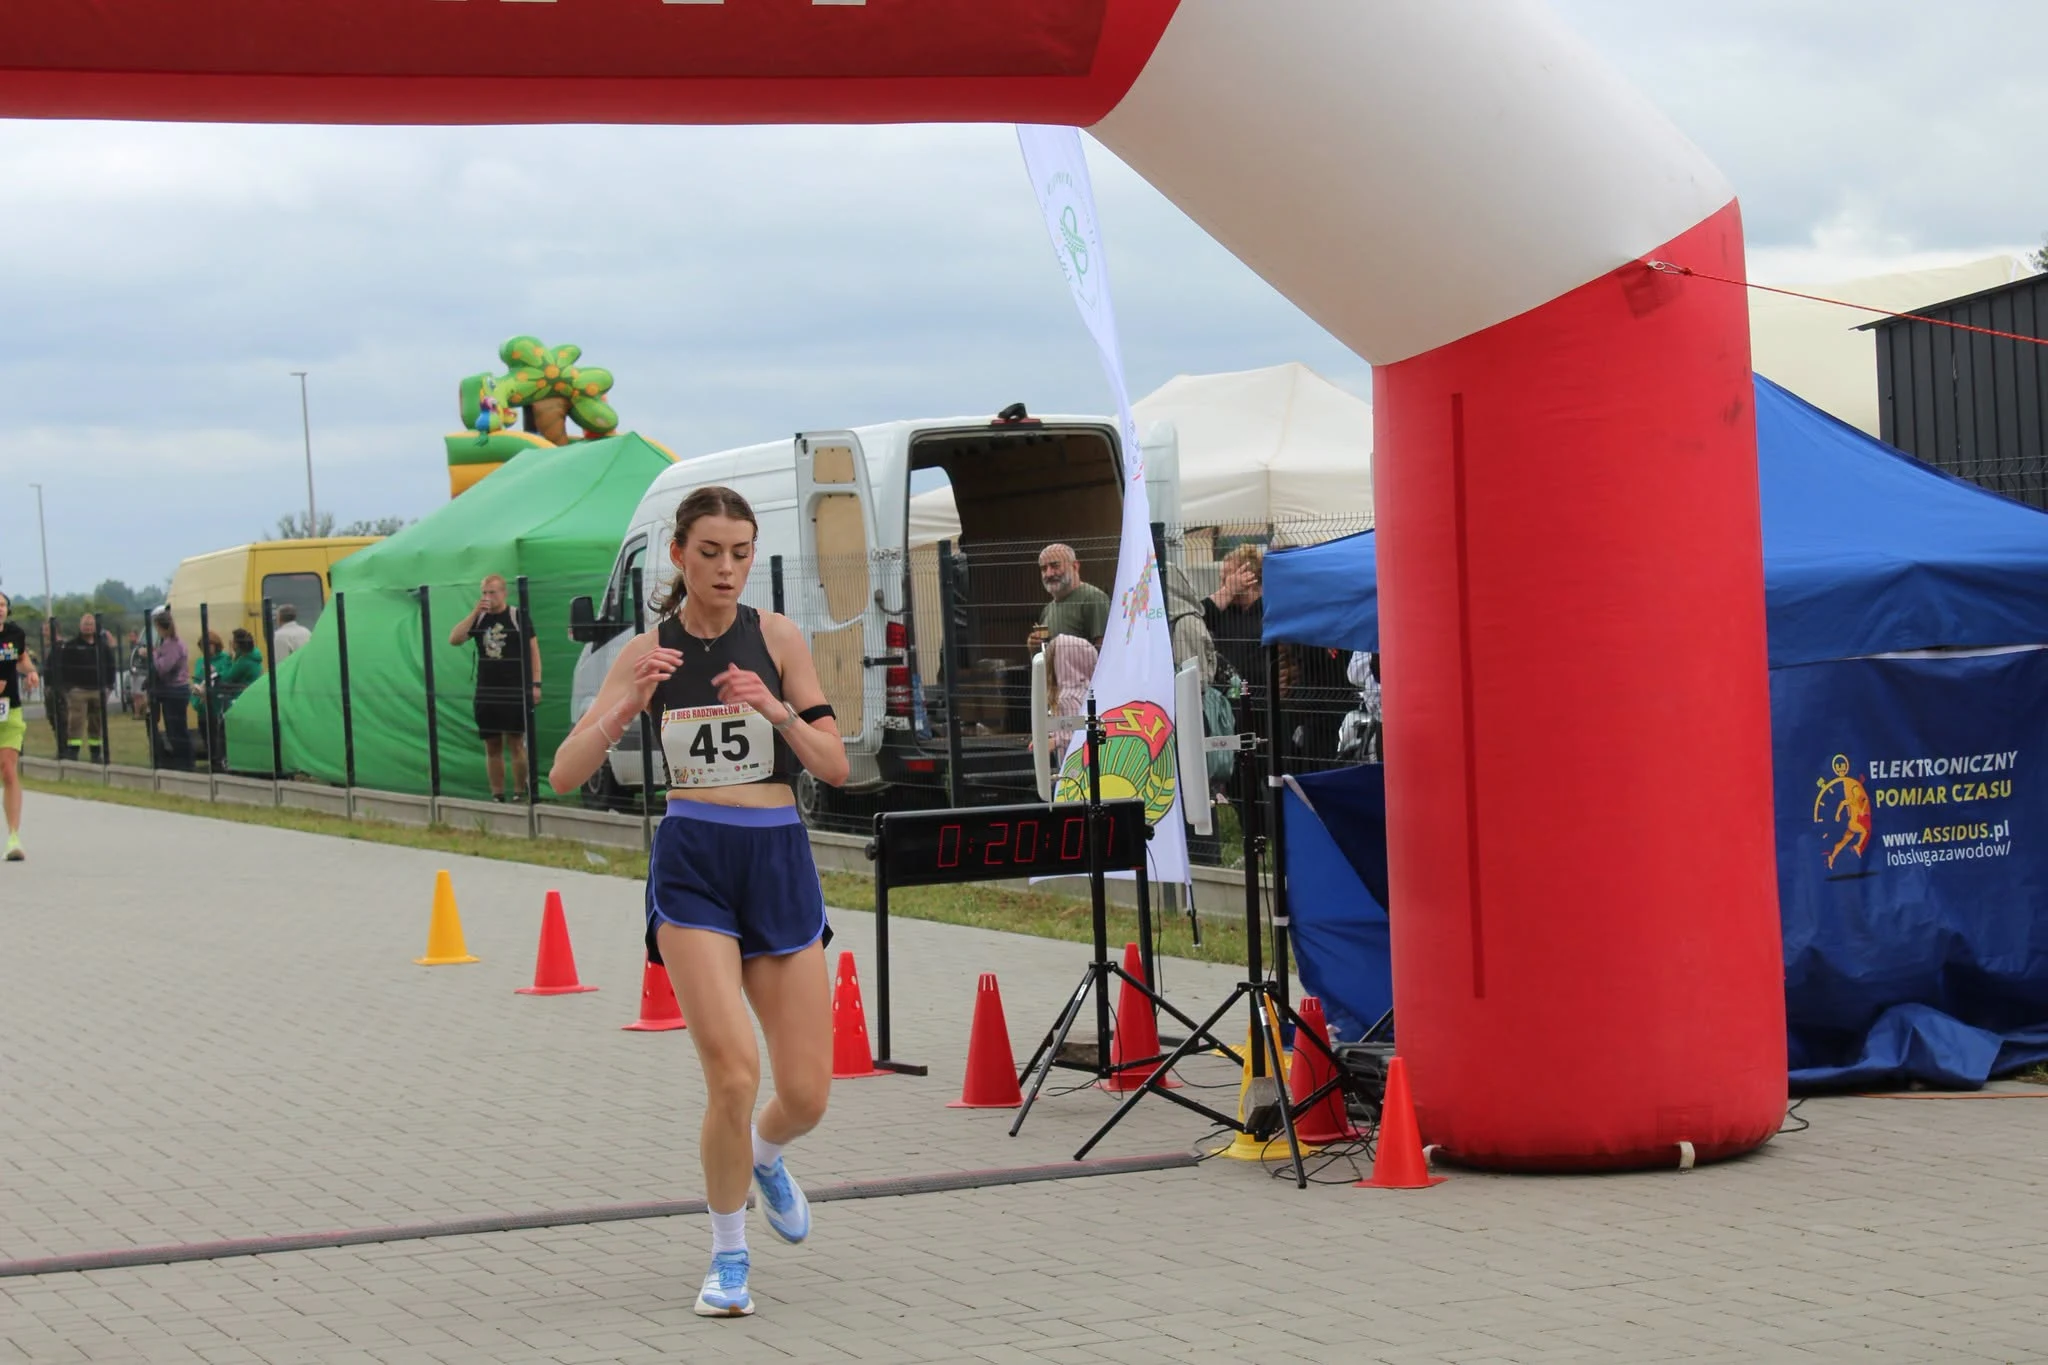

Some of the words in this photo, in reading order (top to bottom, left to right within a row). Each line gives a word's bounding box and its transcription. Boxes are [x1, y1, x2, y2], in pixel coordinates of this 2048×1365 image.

[677, 709, 691, 720] BIEG
[689, 720, 750, 764] 45
[1869, 751, 2018, 779] ELEKTRONICZNY
[1875, 787, 1947, 808] POMIAR
[1951, 780, 2012, 802] CZASU
[1882, 820, 2009, 848] www.ASSIDUS.pl
